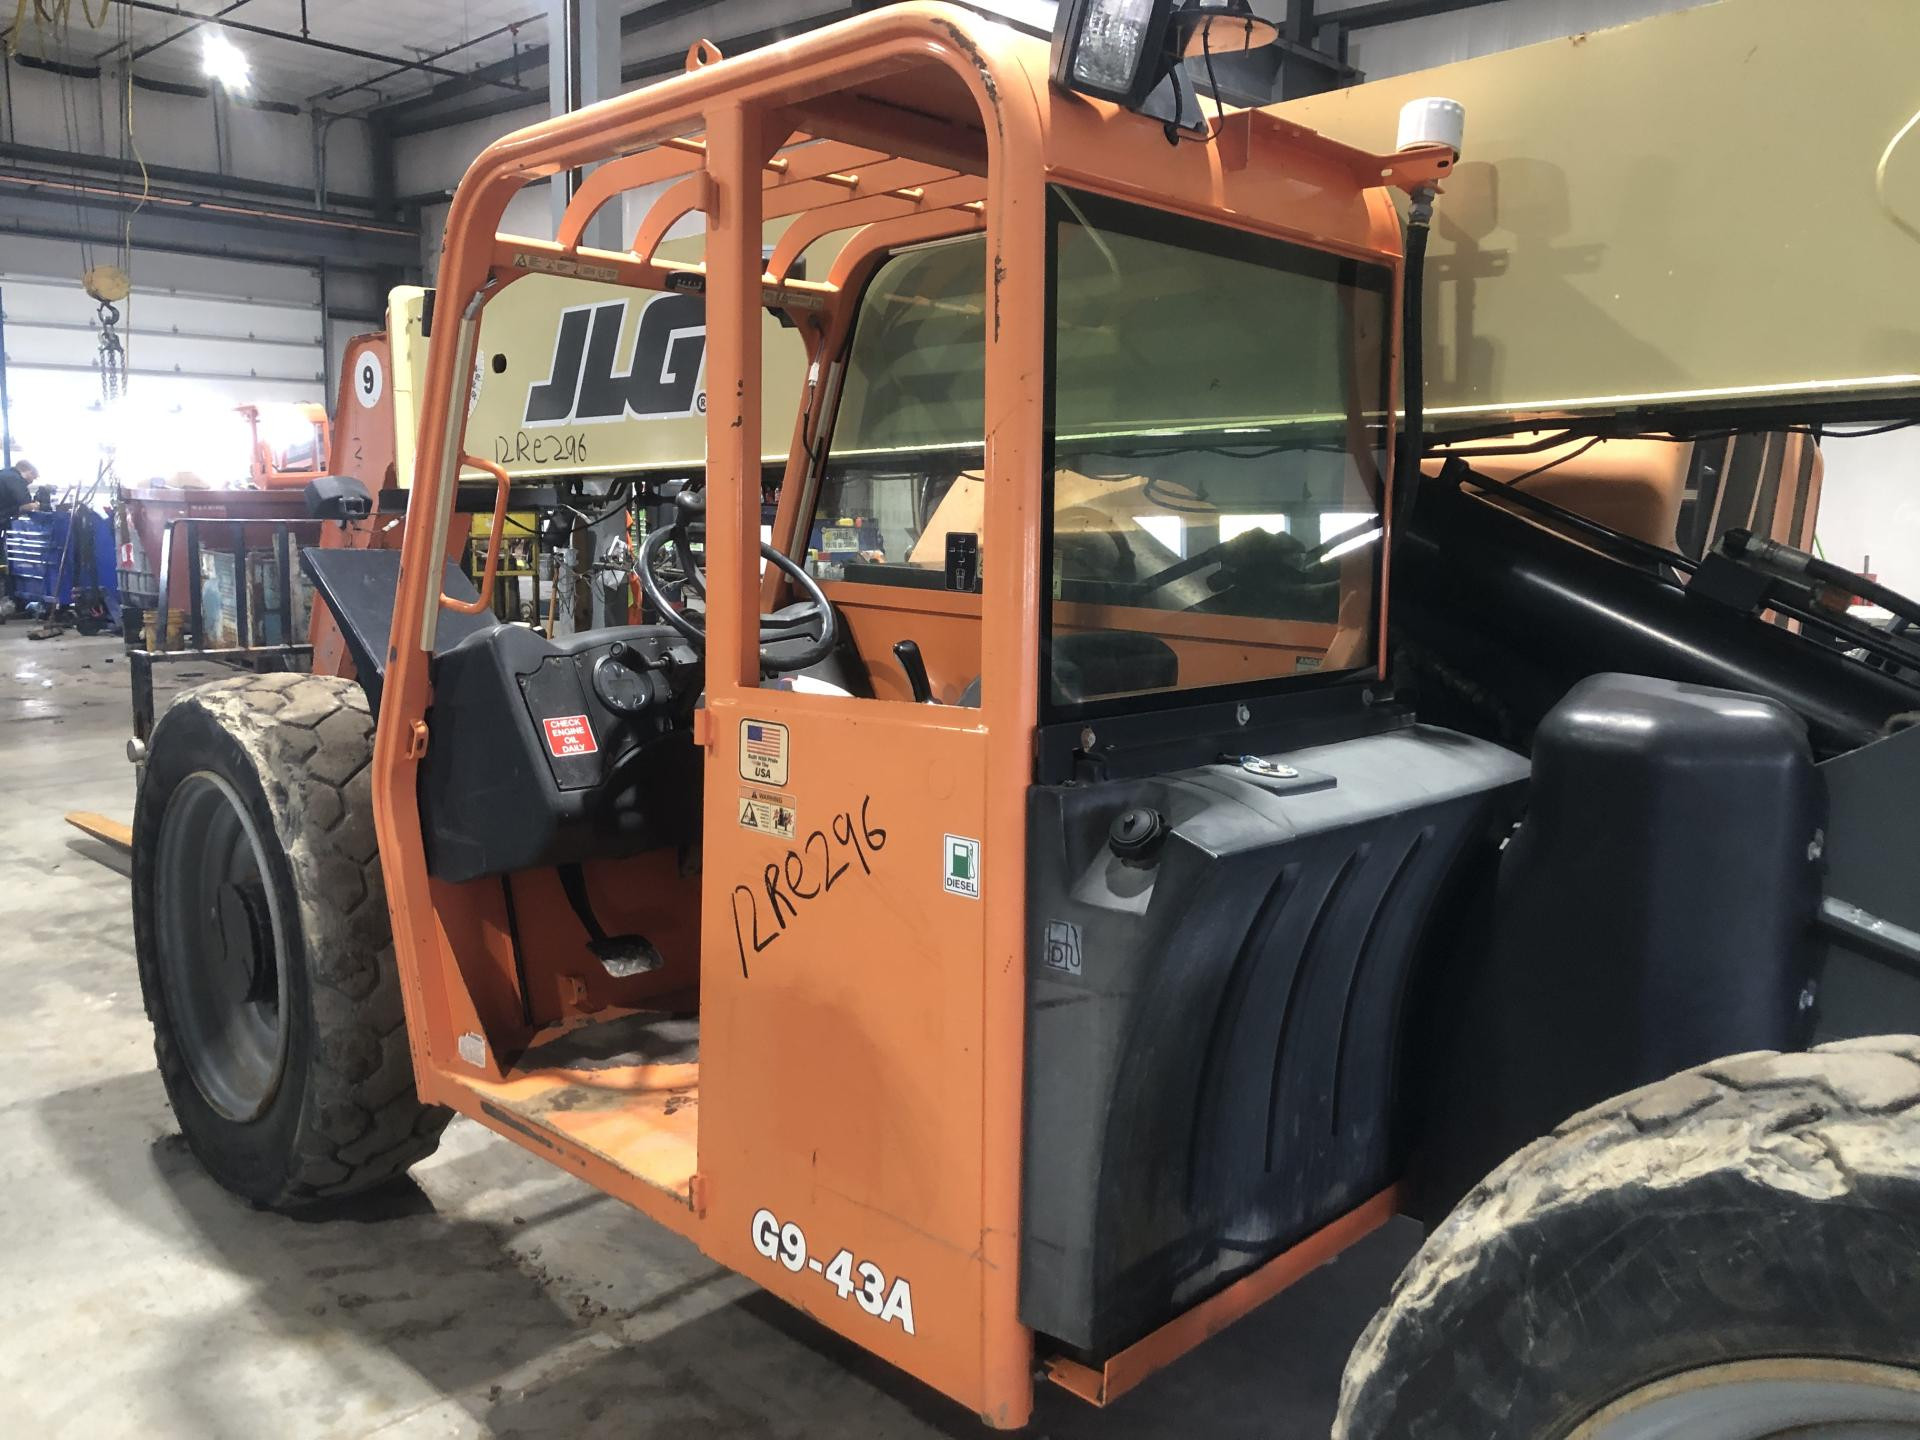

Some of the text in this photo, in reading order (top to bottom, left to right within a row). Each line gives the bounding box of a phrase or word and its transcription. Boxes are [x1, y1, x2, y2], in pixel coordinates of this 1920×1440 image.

[522, 291, 706, 428] JLG
[363, 365, 374, 394] 9
[550, 718, 581, 728] CHECK
[552, 727, 585, 737] ENGINE
[564, 736, 579, 744] OIL
[562, 744, 585, 753] DAILY
[755, 767, 771, 778] USA
[759, 793, 783, 804] WARNING
[946, 877, 977, 893] DIESEL
[751, 1207, 916, 1337] G9-43A
